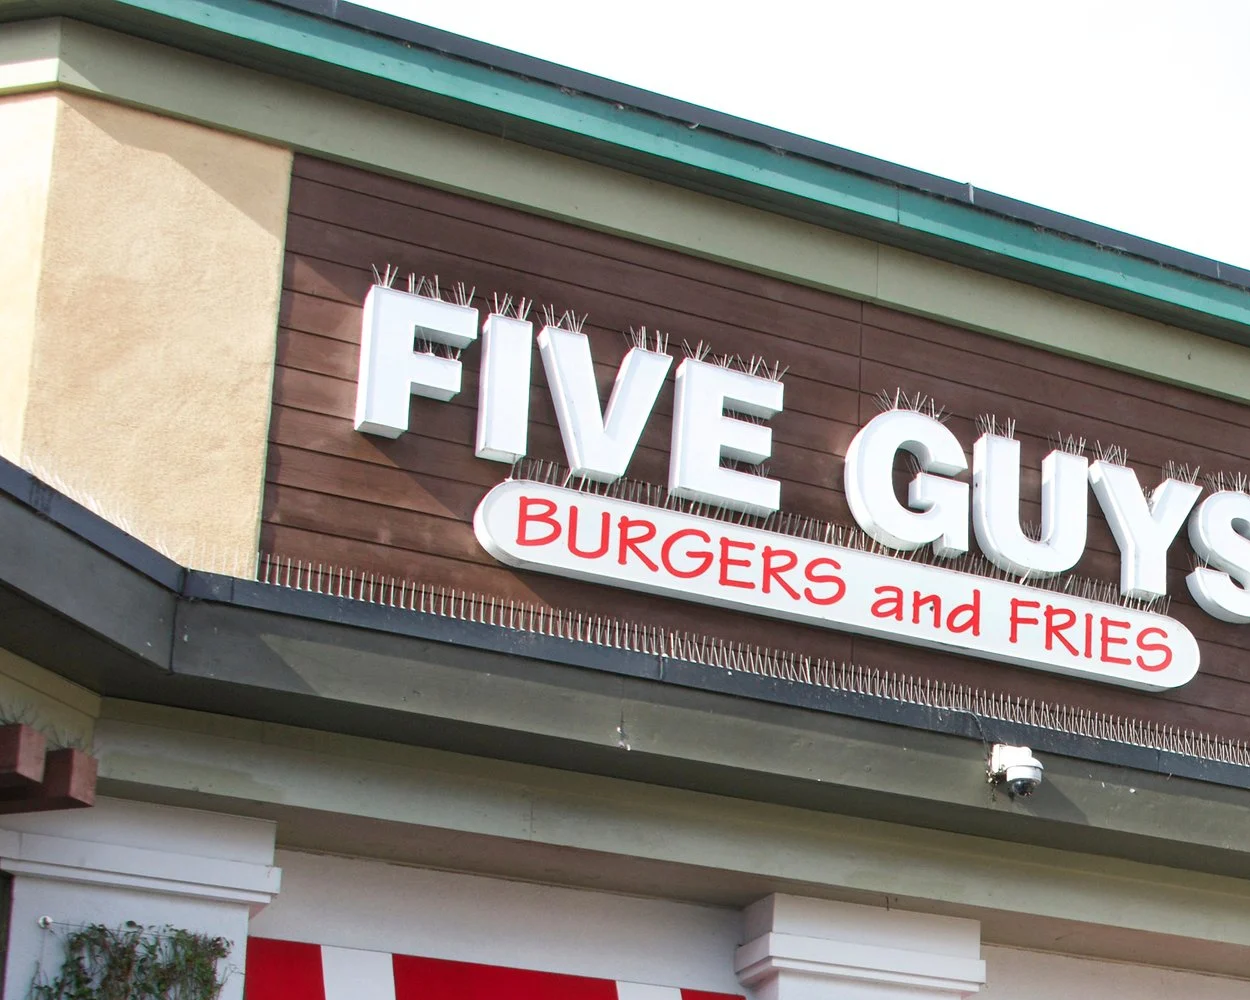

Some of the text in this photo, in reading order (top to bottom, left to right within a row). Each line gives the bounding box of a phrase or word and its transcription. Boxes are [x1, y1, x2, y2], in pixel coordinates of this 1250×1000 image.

[354, 284, 783, 517] FIVE
[515, 496, 1172, 672] BURGERS and FRIES
